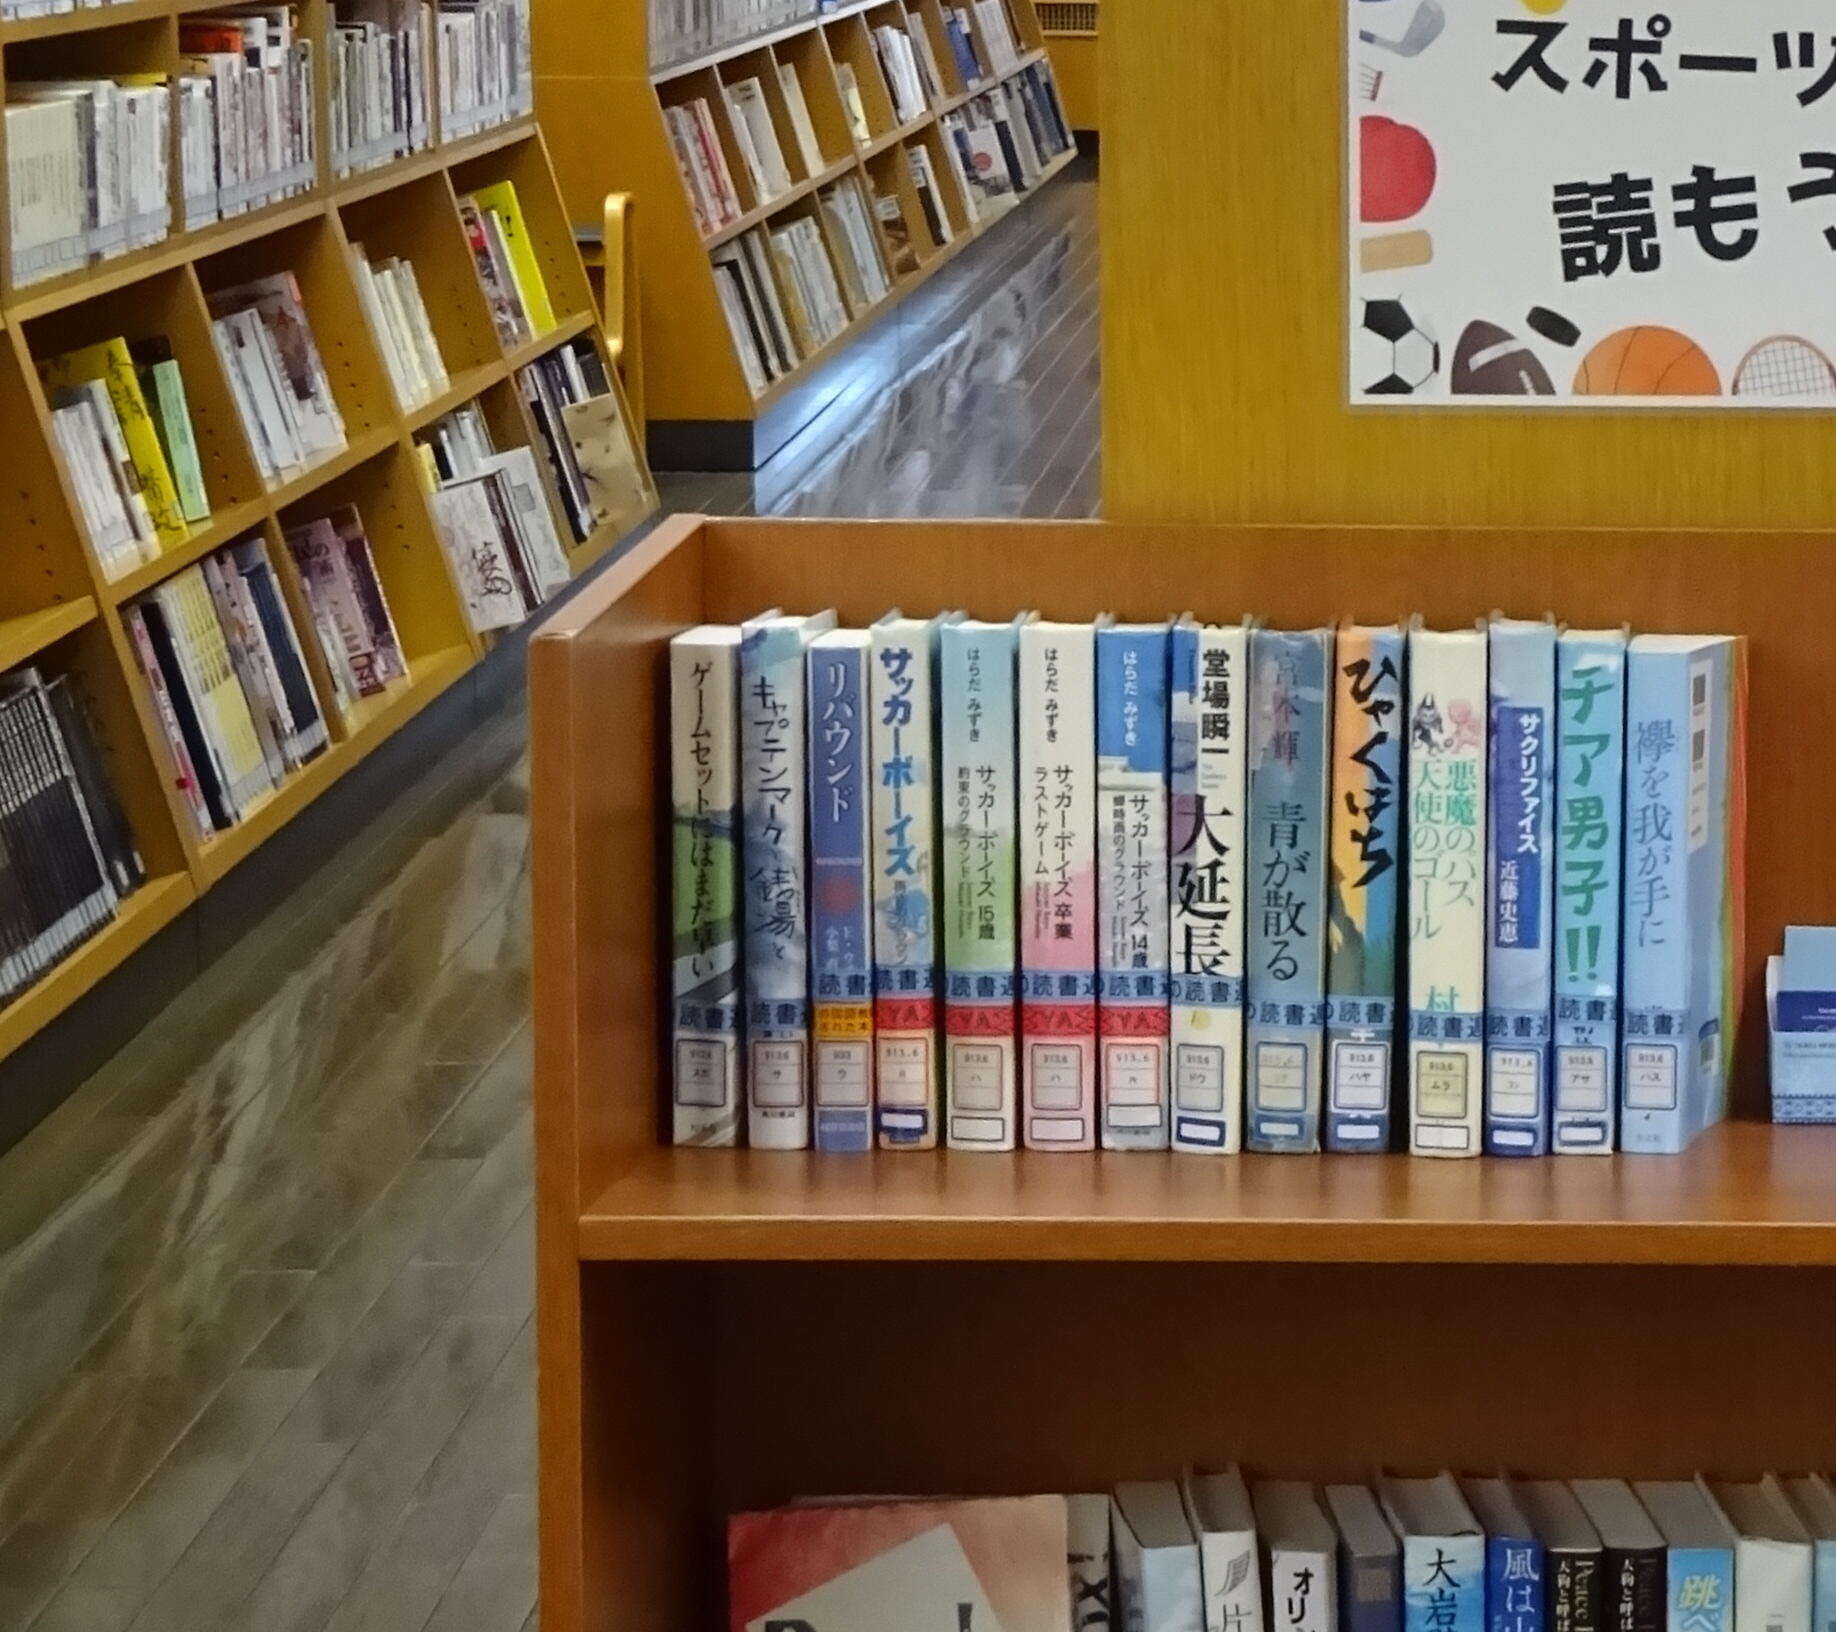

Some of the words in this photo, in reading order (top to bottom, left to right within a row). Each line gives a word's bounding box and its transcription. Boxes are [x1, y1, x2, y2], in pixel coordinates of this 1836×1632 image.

[967, 648, 981, 691] はらだ
[967, 698, 981, 742] みずき
[1044, 648, 1058, 691] はらだ
[1045, 698, 1058, 742] みずき
[1123, 651, 1138, 695] はらだ
[1123, 702, 1138, 746] みずき
[1200, 647, 1231, 756] 堂場瞬一
[1271, 649, 1300, 765] 宮本輝
[822, 663, 856, 823] リバウンド
[879, 647, 916, 876] サッカーボーイズ
[1343, 655, 1398, 888] ひゃくはち
[1516, 713, 1542, 854] サクリファイス
[976, 765, 997, 898] サッカーボーイズ
[1034, 767, 1049, 875] ラストゲーム
[1053, 765, 1075, 898] サッカーボーイズ
[1129, 794, 1150, 928] サッカーボーイズ
[1412, 759, 1442, 941] 天使のゴール
[1444, 759, 1476, 906] 悪魔のパス
[1561, 666, 1618, 981] チア男子!!
[1631, 719, 1677, 949] 襷を我が手に
[978, 905, 996, 941] 15歳
[1054, 902, 1074, 940] 卒業
[1175, 794, 1233, 977] 大延長
[1261, 799, 1309, 981] 青が散る
[1499, 859, 1519, 945] 近藤史恵
[1131, 934, 1149, 969] 14歳
